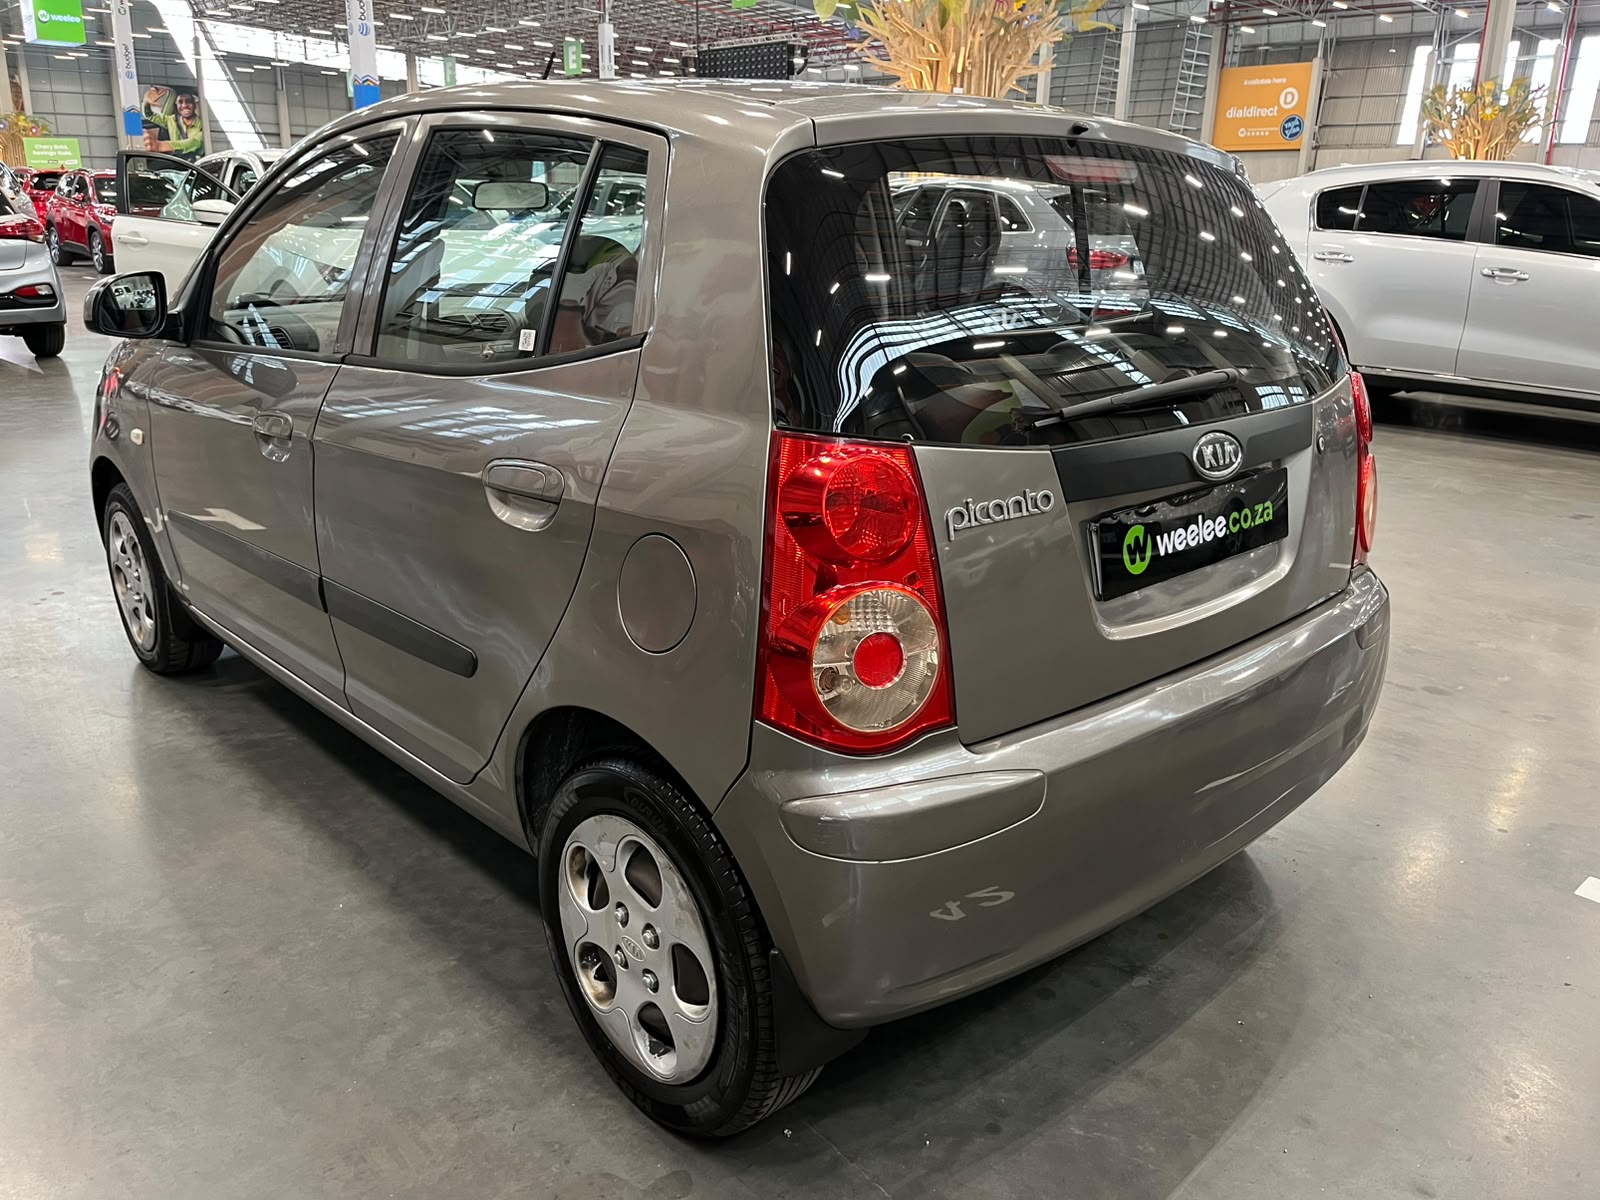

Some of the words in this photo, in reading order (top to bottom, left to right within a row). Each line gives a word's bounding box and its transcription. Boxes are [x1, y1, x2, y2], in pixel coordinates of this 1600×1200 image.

[51, 14, 81, 23] weelee
[1226, 106, 1278, 118] dialdirect
[1201, 442, 1238, 469] KIA
[943, 488, 1055, 541] picanto
[1156, 500, 1273, 557] weelee.co.za
